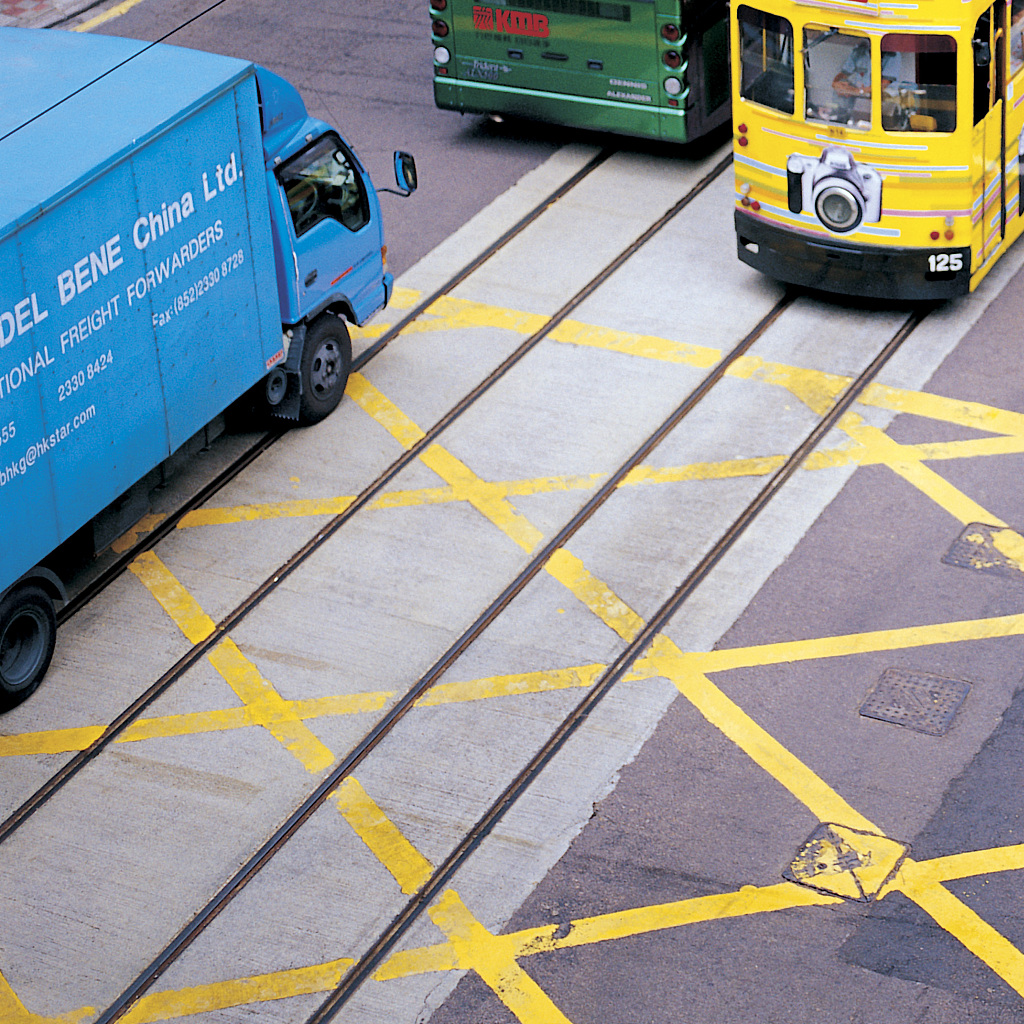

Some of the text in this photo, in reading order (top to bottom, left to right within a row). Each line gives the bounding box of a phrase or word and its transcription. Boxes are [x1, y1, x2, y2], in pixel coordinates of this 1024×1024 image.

[495, 8, 550, 38] KMB
[57, 234, 124, 306] BENE
[133, 192, 195, 250] China
[202, 152, 244, 202] Ltd.
[221, 249, 244, 278] 8728
[927, 253, 963, 273] 125
[60, 294, 120, 355] FREIGHT
[126, 219, 224, 306] FORWARDERS
[58, 349, 113, 402] 2330 8424
[0, 421, 16, 447] 55
